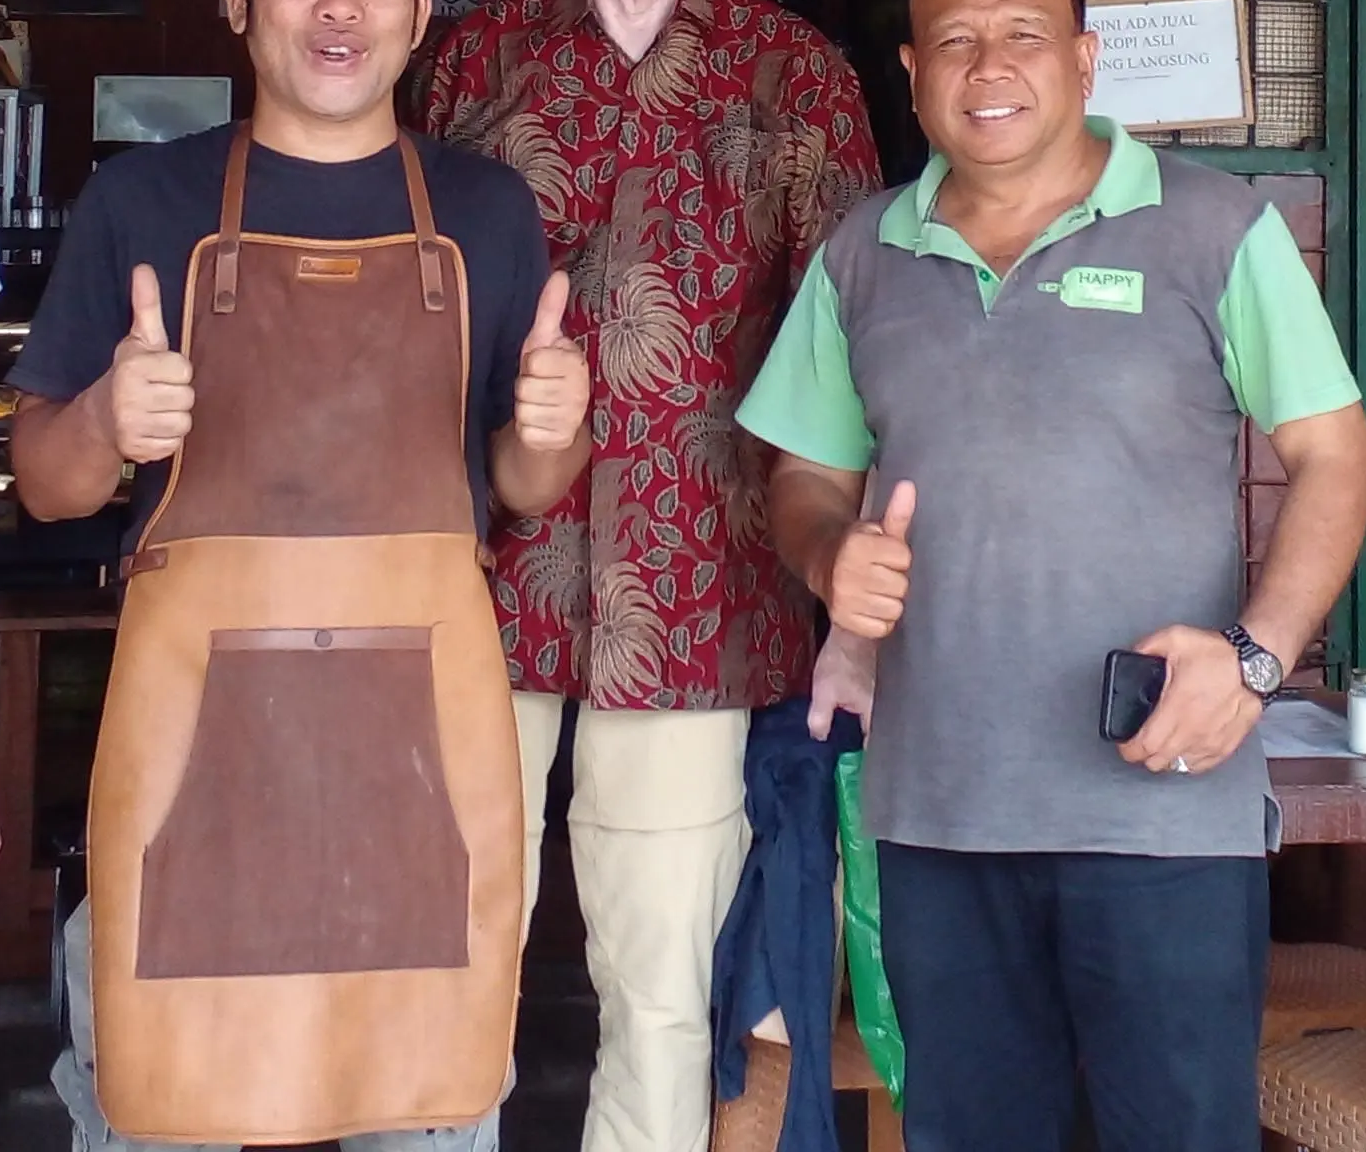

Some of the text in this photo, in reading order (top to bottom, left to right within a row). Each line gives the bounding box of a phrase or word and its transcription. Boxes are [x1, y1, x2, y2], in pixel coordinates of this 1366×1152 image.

[1126, 16, 1158, 31] ADA
[1161, 13, 1199, 28] JUAL
[1102, 33, 1176, 51] KOPI ASLI
[1126, 52, 1212, 70] LANGSUNG
[1079, 272, 1136, 288] HAPPY
